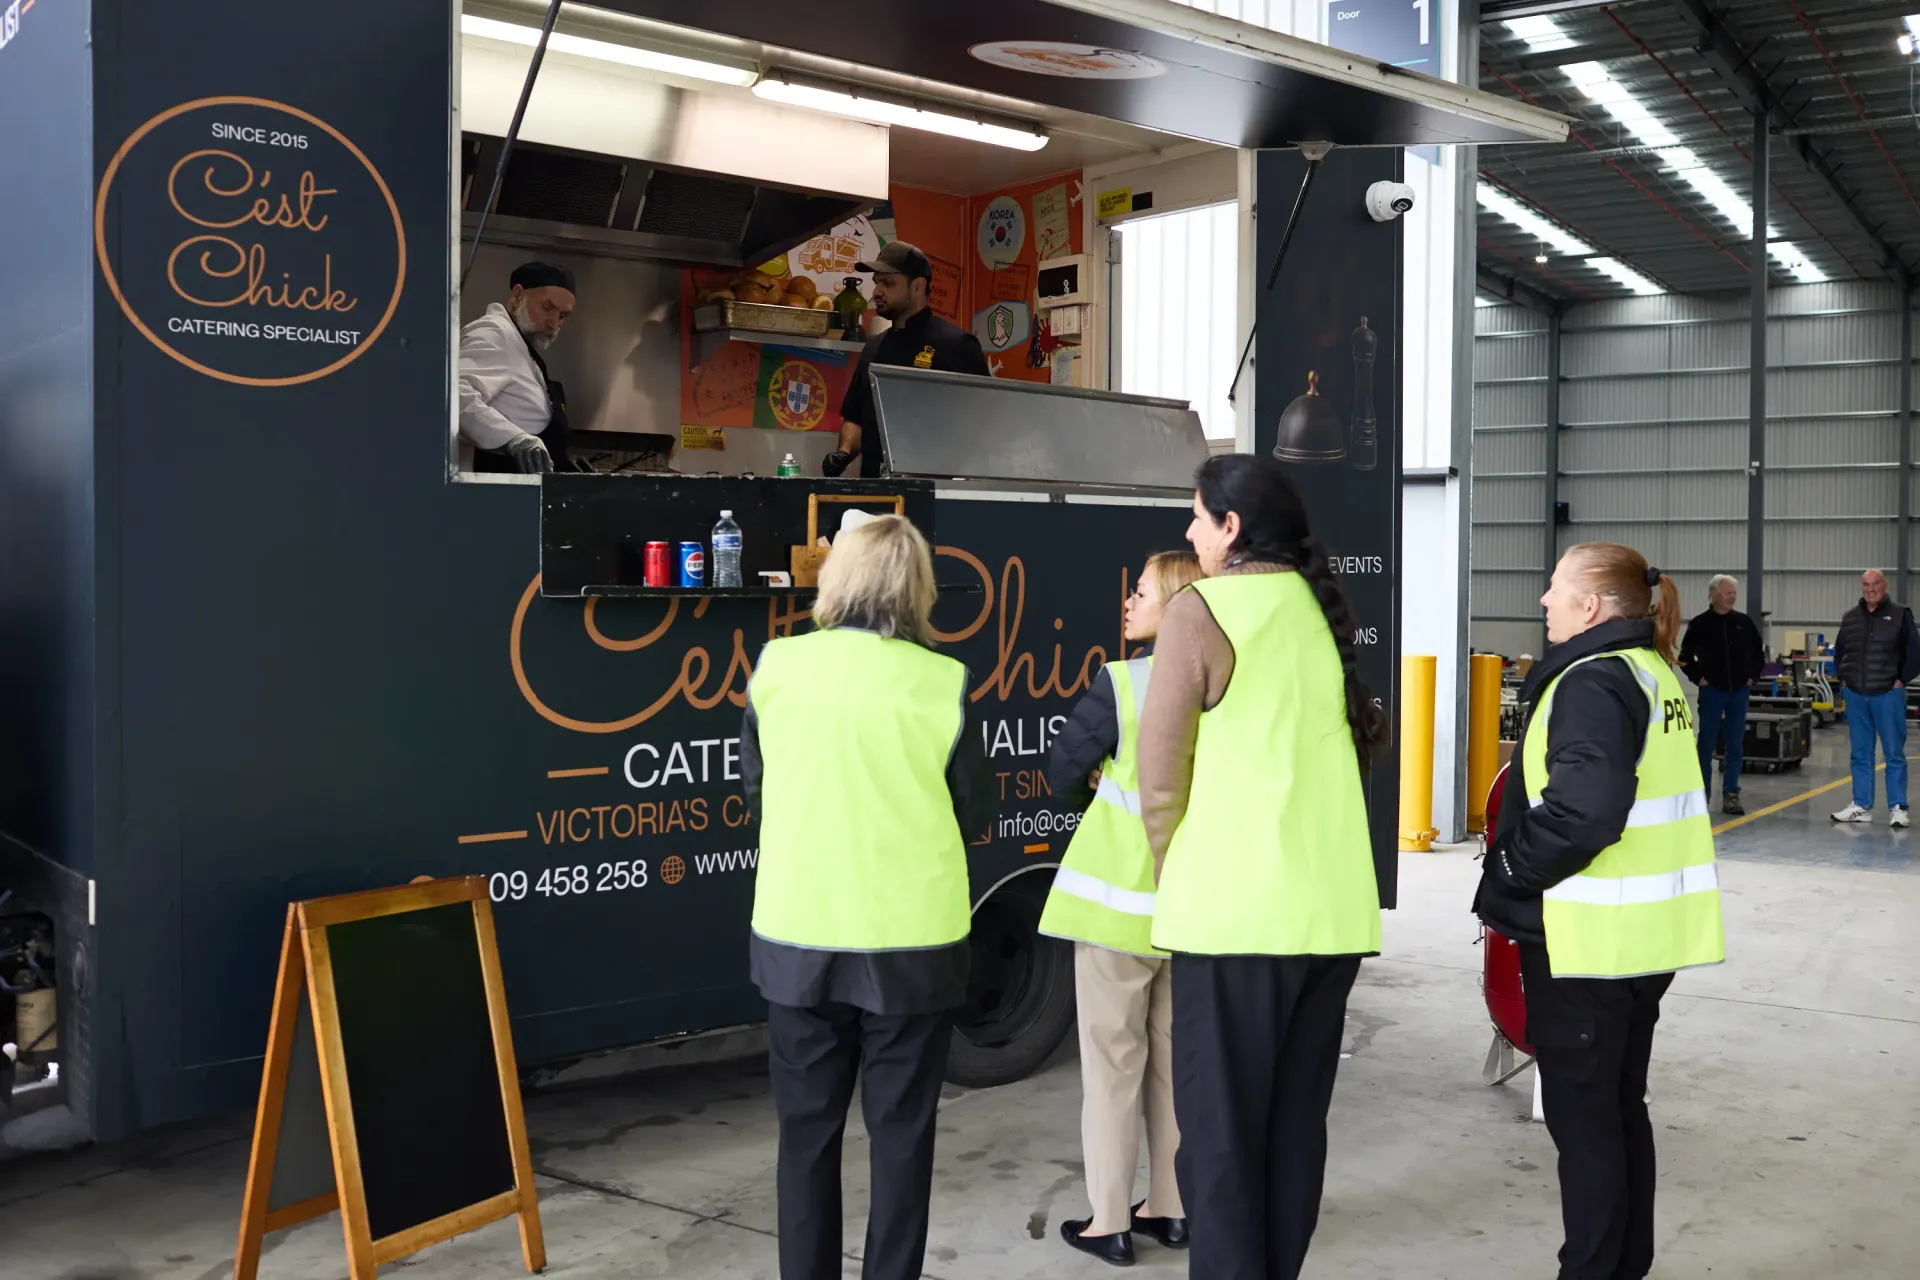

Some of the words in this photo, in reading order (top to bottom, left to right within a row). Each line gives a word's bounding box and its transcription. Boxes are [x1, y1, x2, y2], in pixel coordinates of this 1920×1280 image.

[1337, 10, 1361, 21] Door
[1413, 0, 1429, 45] 1
[212, 122, 266, 144] SINCE
[270, 131, 309, 149] 2015
[167, 149, 338, 231] C'est
[989, 209, 1015, 220] KOREA
[167, 235, 358, 312] Chick
[168, 317, 260, 338] CATERING
[263, 325, 361, 345] SPECIALIST
[1328, 556, 1383, 574] EVENTS
[1353, 627, 1378, 645] NS
[536, 797, 709, 845] VICTORIA'S
[489, 870, 528, 902] 09
[535, 864, 590, 898] 458
[596, 859, 649, 892] 258
